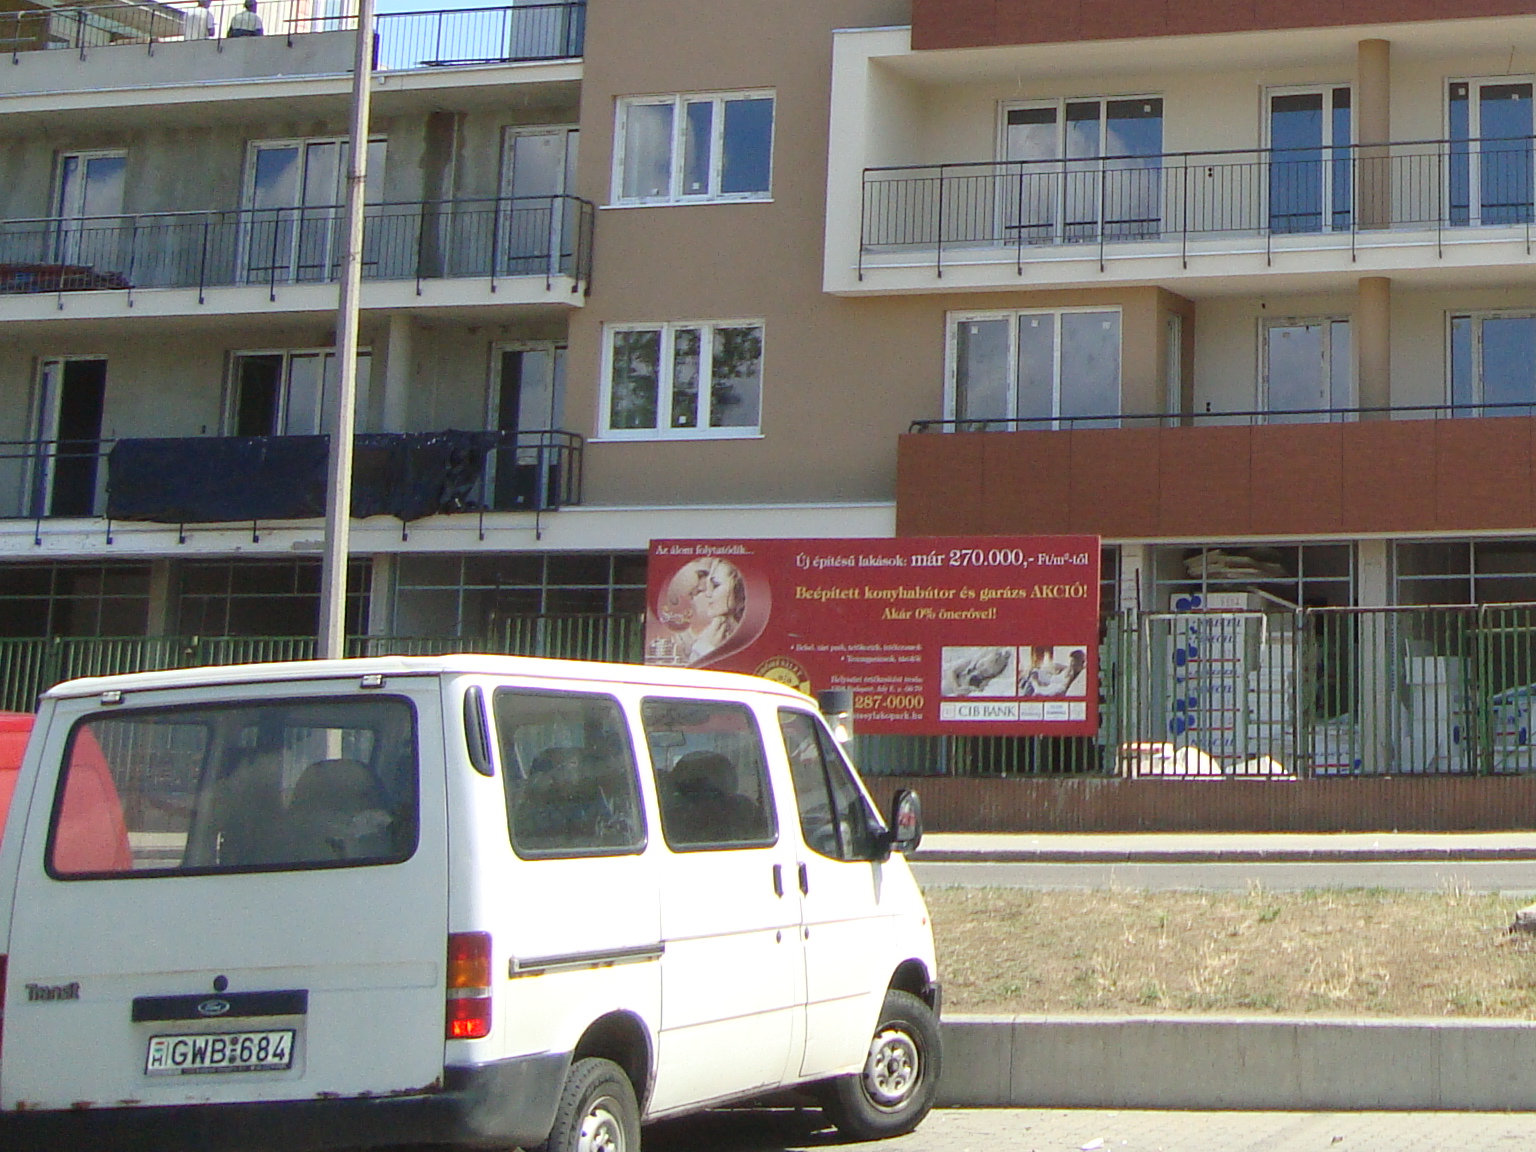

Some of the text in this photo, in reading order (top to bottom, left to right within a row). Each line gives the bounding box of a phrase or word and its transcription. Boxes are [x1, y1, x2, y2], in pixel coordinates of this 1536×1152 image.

[656, 545, 668, 555] Az
[796, 552, 810, 569] Új
[813, 554, 855, 569] építésű
[858, 554, 907, 567] lakások:
[911, 551, 945, 567] már
[950, 549, 1034, 568] 270.000,-
[795, 582, 1088, 602] Beépített konyhabútor és garázs AKCIÓ!
[882, 607, 912, 620] Akár
[915, 608, 936, 620] 0%
[854, 695, 924, 709] 287-0000
[958, 705, 980, 717] CIB
[983, 705, 1016, 717] BANK
[25, 981, 81, 1001] Transit
[152, 1054, 163, 1067] H
